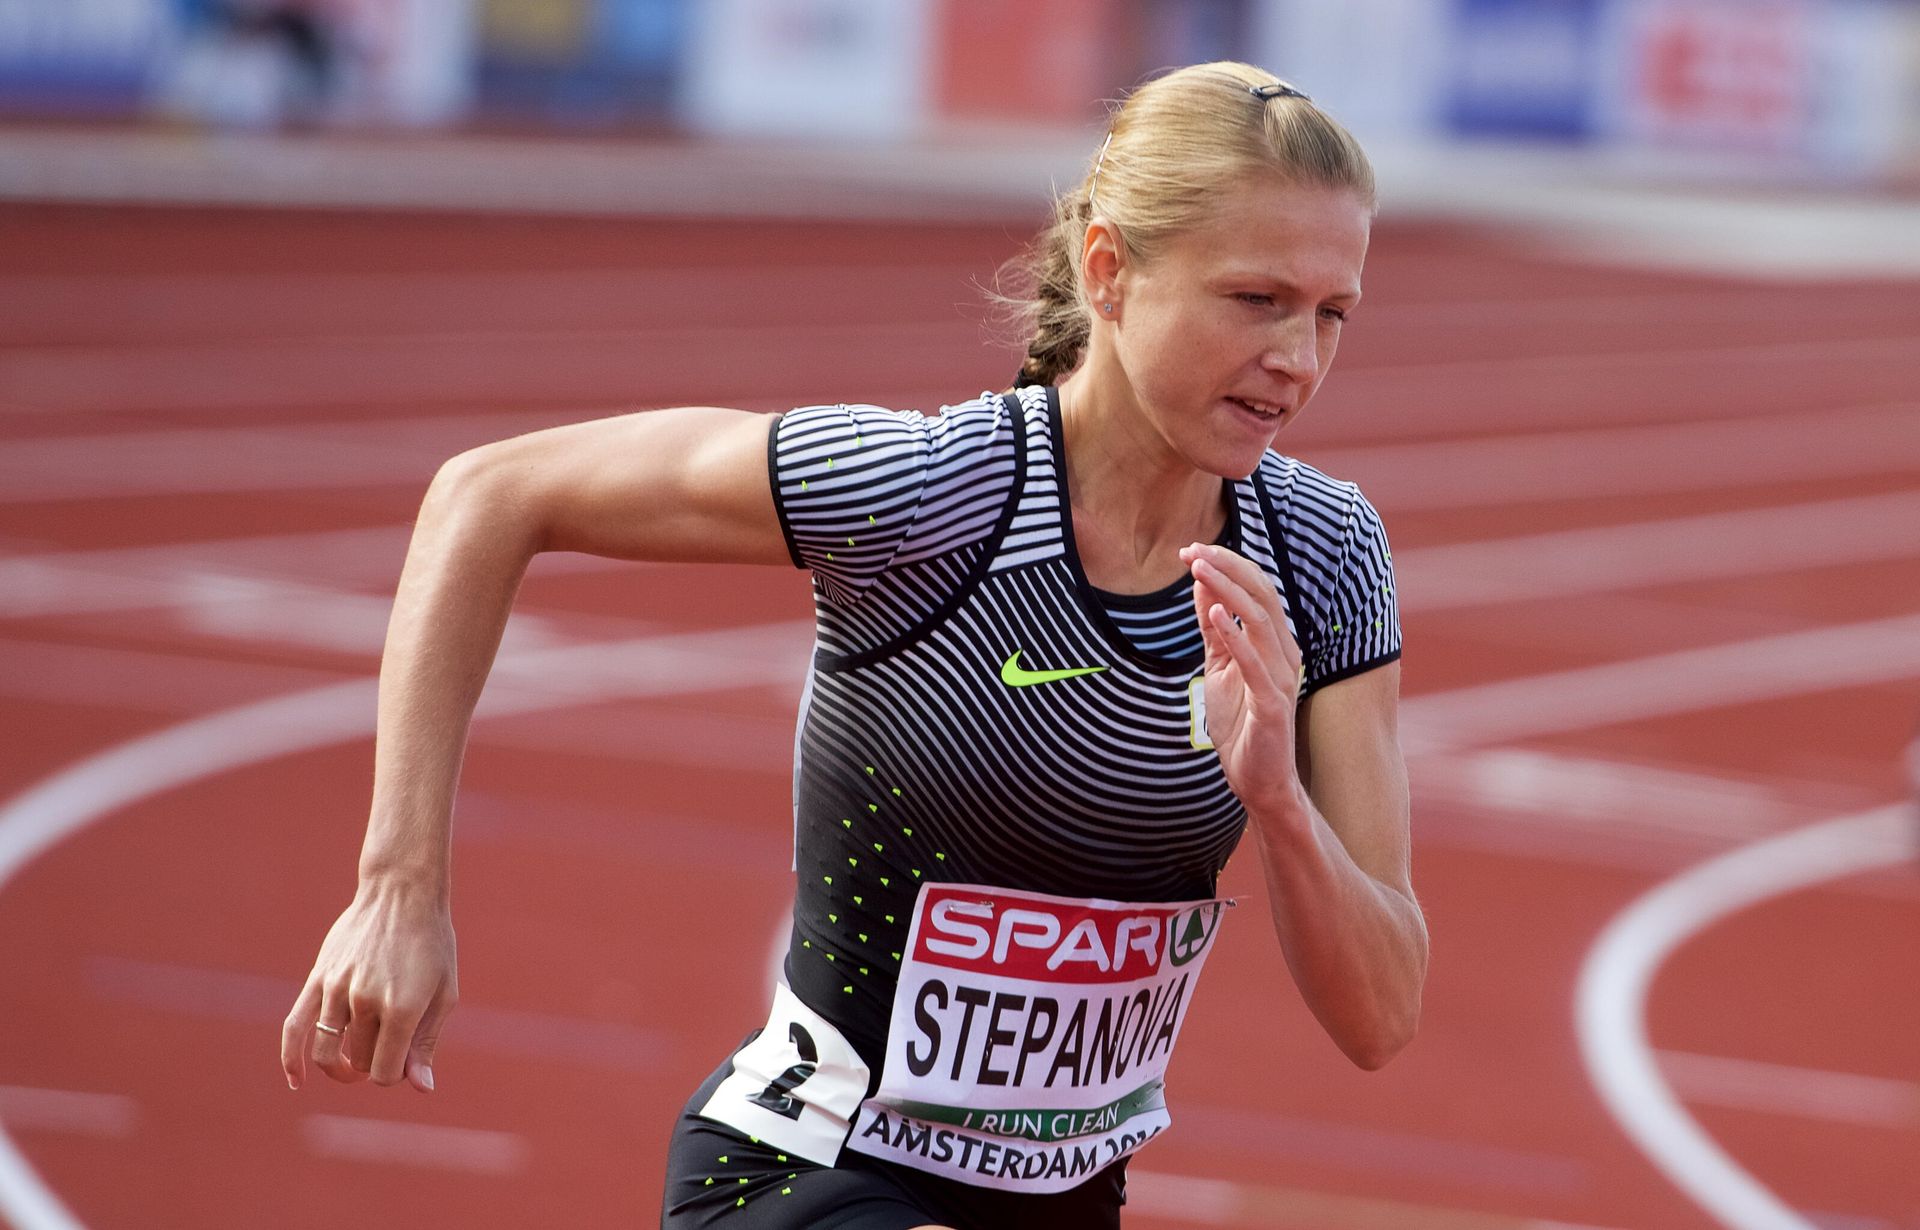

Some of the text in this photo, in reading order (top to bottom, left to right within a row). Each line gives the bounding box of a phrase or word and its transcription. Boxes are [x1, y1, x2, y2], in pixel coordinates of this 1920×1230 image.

[926, 899, 1161, 972] SPAR
[906, 973, 1189, 1088] STEPANOVA
[745, 1021, 819, 1122] 2
[862, 1111, 1098, 1181] AMSTERDAM
[980, 1114, 1044, 1138] RUN
[1051, 1102, 1121, 1138] CLEAN
